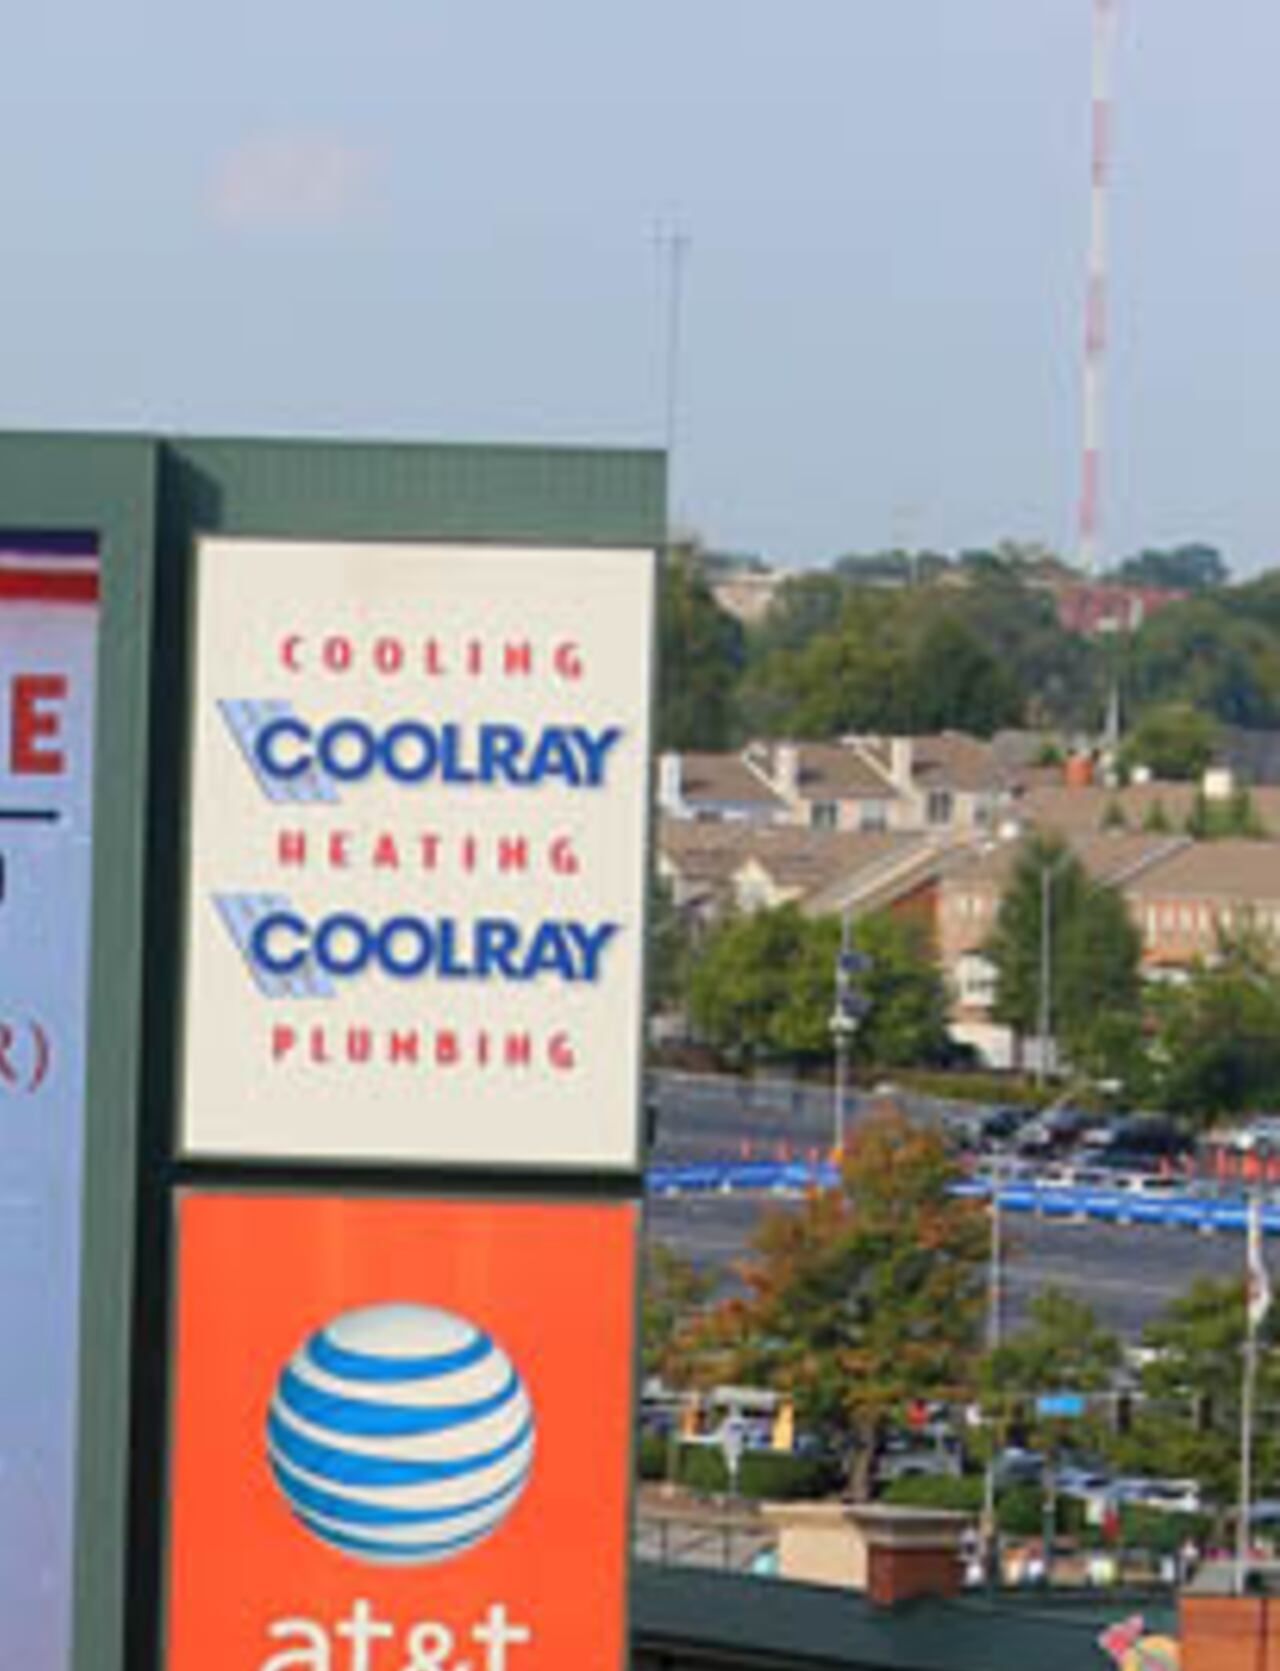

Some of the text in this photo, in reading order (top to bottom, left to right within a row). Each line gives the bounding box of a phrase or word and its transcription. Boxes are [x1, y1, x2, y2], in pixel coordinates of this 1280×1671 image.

[281, 635, 582, 679] COOLING
[254, 716, 625, 788] COOLRAY
[278, 831, 579, 875] HEATING
[250, 911, 621, 982] COOLRAY
[272, 1024, 575, 1071] PLUMBING
